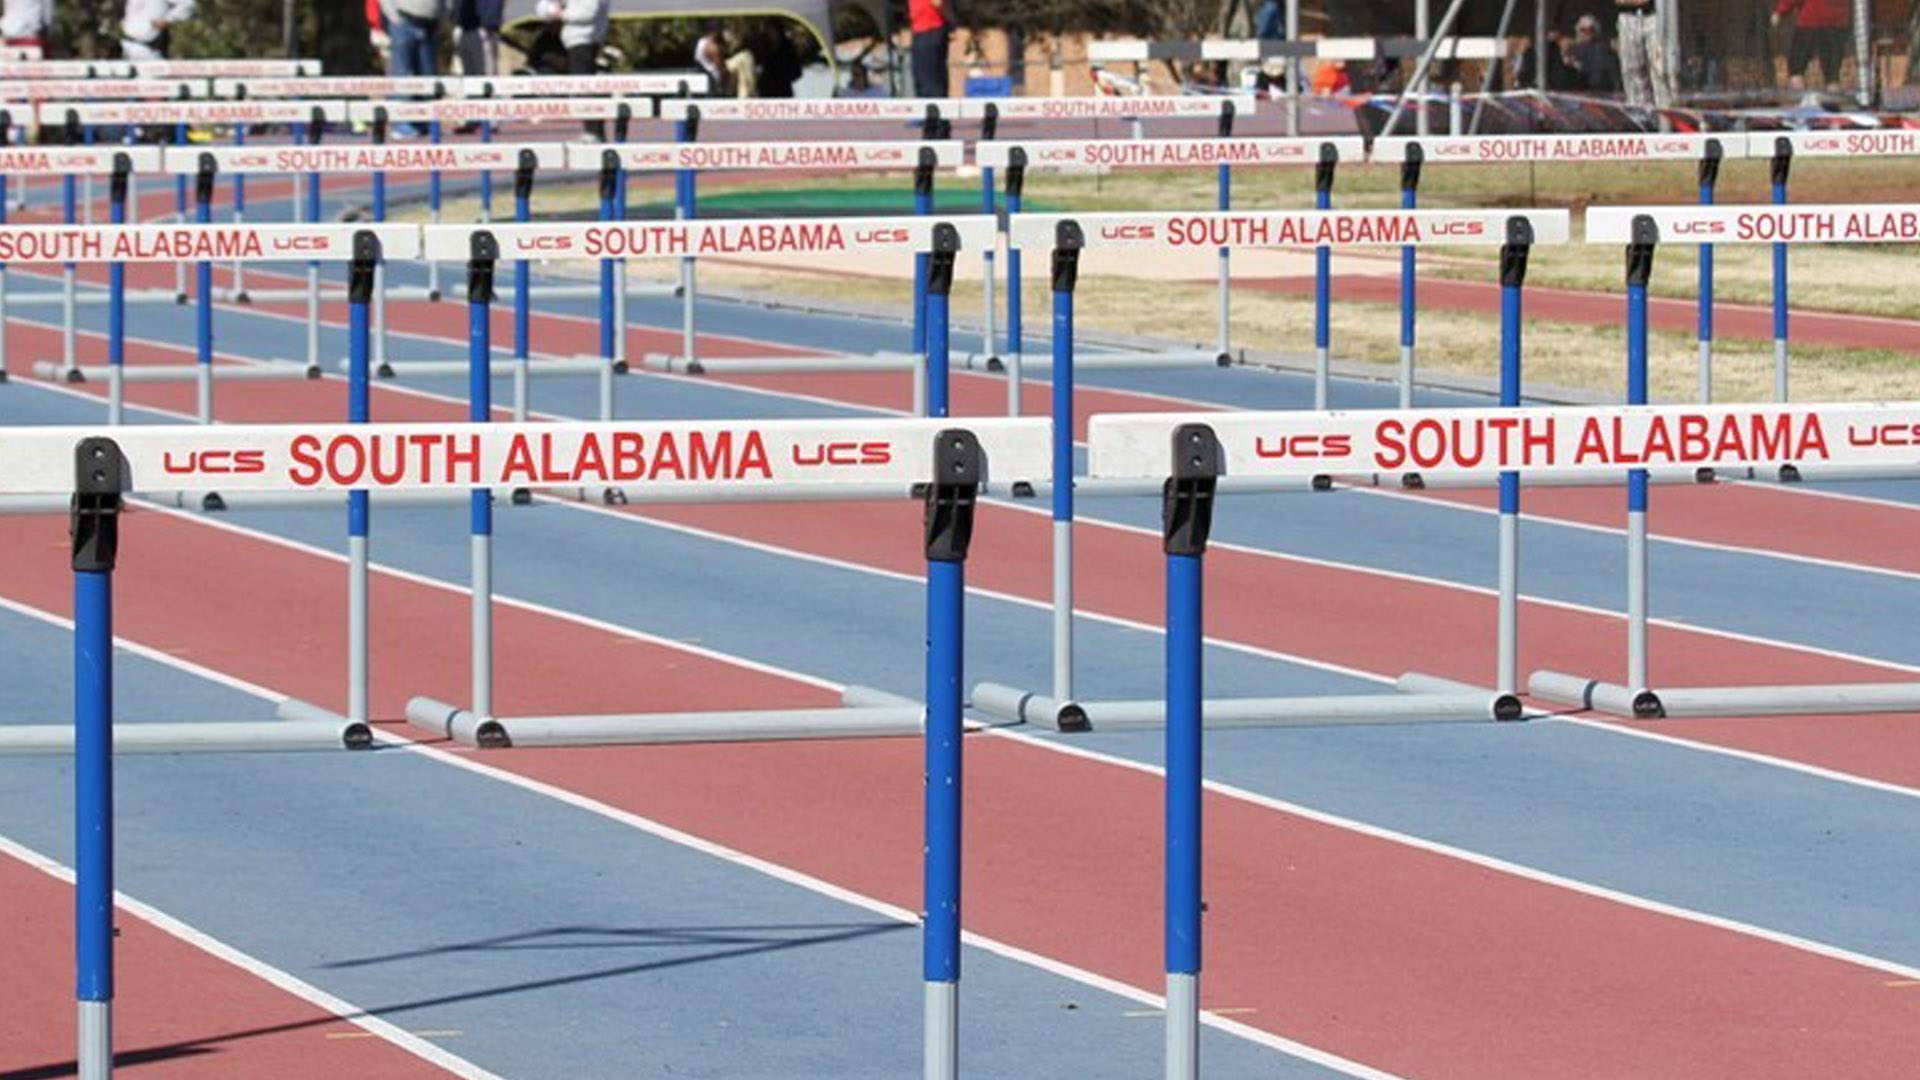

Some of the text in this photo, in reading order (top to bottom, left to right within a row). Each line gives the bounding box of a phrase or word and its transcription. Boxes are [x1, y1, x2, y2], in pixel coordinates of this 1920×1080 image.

[126, 107, 181, 120] SOUTH
[189, 106, 262, 119] ALABAMA
[434, 105, 490, 118] SOUTH
[495, 105, 570, 116] ALABAMA
[744, 105, 801, 117] SOUTH
[804, 105, 880, 115] ALABAMA
[1043, 103, 1098, 115] SOUTH
[1101, 101, 1173, 114] ALABAMA
[1086, 145, 1156, 164] SOUTH
[1163, 144, 1261, 162] ALABAMA
[1479, 140, 1547, 159] SOUTH
[1555, 139, 1646, 157] ALABAMA
[1848, 135, 1914, 155] SOUTH
[0, 153, 49, 170] AMA
[278, 150, 349, 169] SOUTH
[358, 150, 457, 168] ALABAMA
[680, 149, 751, 166] SOUTH
[760, 148, 858, 166] ALABAMA
[1102, 216, 1483, 246] UCS SOUTH ALABAMA UCS
[1674, 214, 1920, 240] UCS SOUTH ALAB
[0, 230, 328, 259] SOUTH ALABAMA UCS
[517, 224, 908, 255] UCS SOUTH ALABAMA UCS
[1256, 435, 1352, 458] UCS
[1374, 418, 1555, 468] SOUTH
[1575, 413, 1829, 463] ALABAMA
[164, 432, 891, 484] UCS SOUTH ALABAMA UCS
